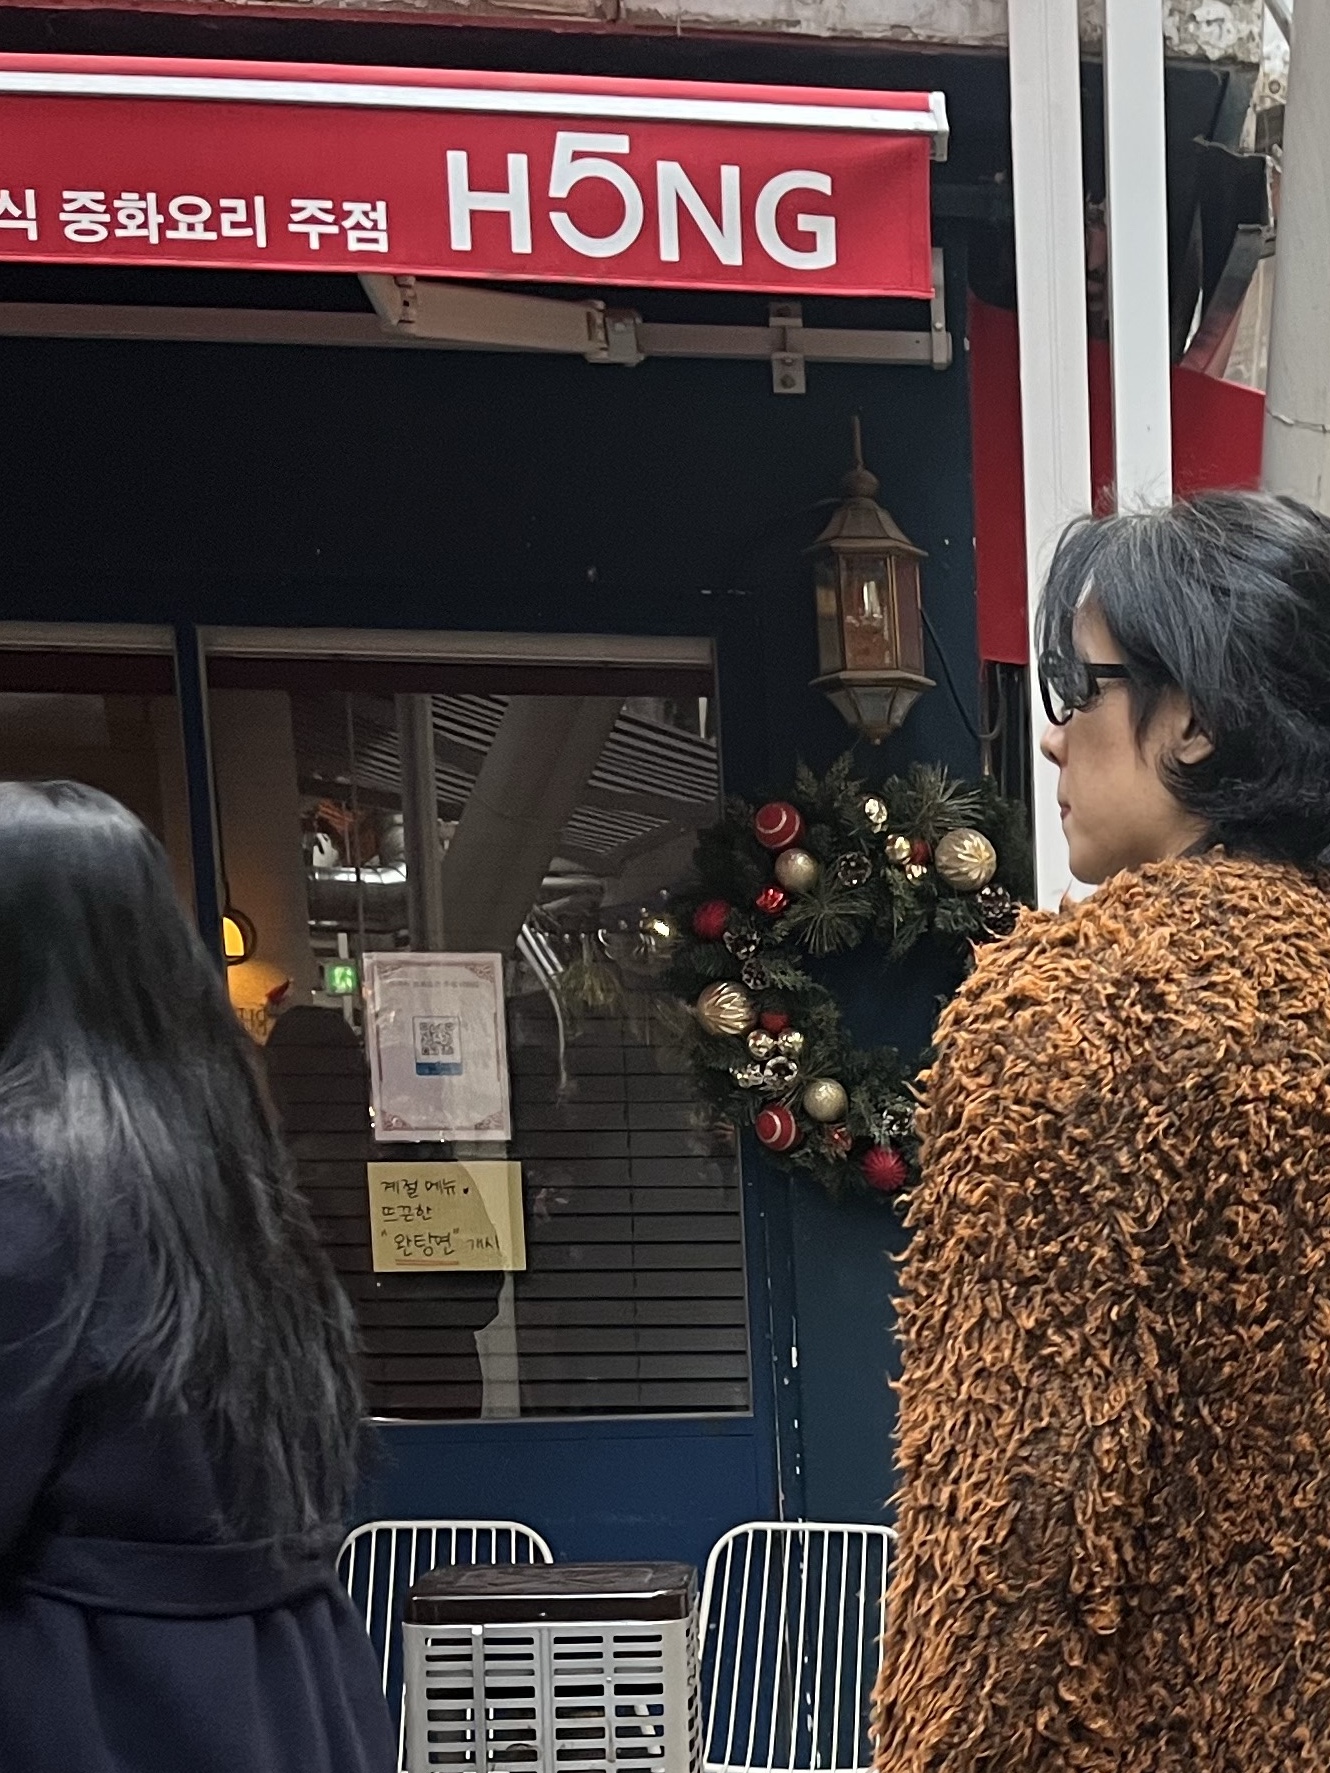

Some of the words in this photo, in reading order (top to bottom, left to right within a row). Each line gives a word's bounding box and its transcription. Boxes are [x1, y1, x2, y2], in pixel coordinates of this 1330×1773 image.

[59, 189, 268, 249] 중화요리
[288, 198, 390, 253] 주점
[380, 1178, 419, 1200] 계절
[464, 1233, 500, 1251] 개시
